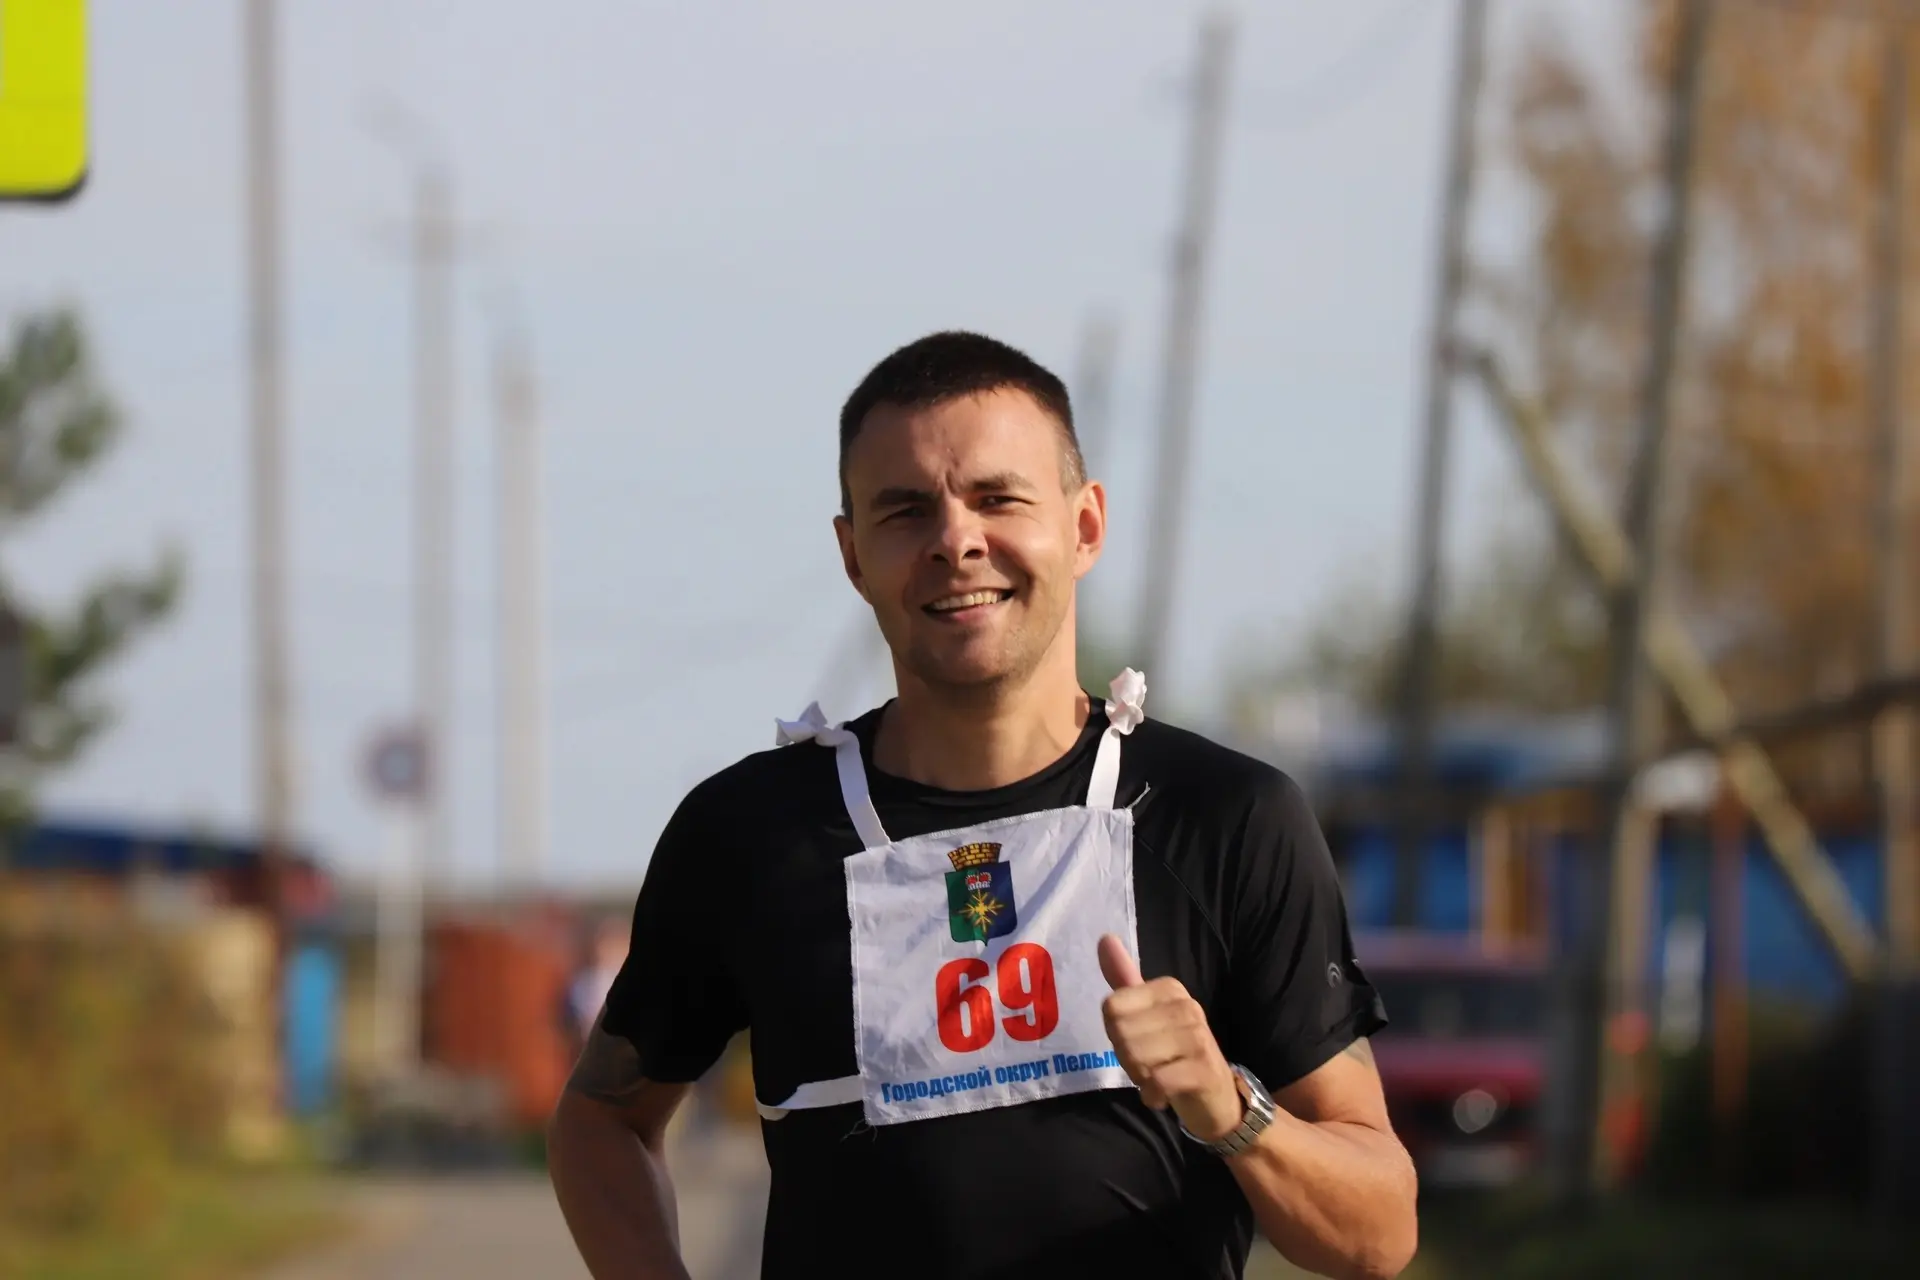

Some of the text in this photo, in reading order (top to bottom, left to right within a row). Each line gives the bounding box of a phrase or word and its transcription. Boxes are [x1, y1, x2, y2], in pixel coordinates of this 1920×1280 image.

[935, 942, 1059, 1053] 69
[881, 1065, 992, 1104] Городской
[995, 1059, 1049, 1084] округ
